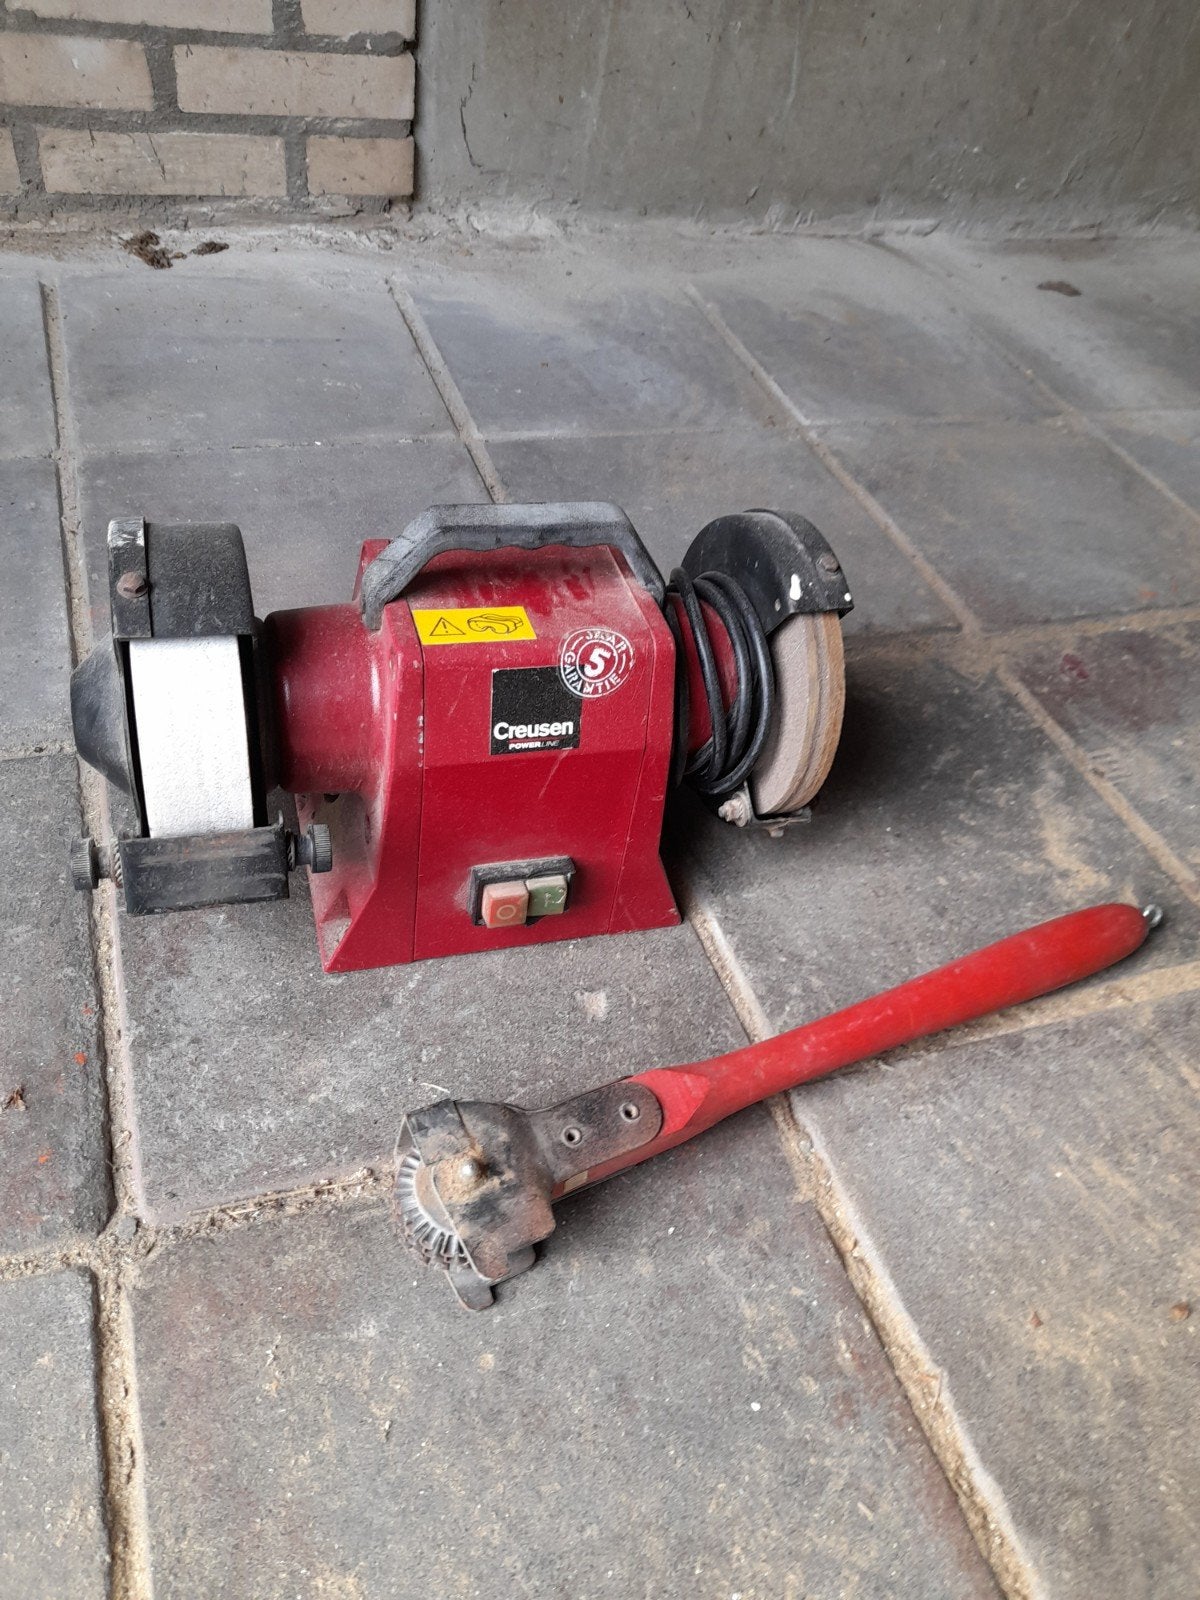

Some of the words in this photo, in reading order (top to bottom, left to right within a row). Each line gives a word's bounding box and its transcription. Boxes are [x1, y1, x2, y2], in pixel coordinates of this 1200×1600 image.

[565, 652, 620, 694] GARANTIE
[584, 646, 611, 677] 5
[493, 721, 574, 740] Creusen
